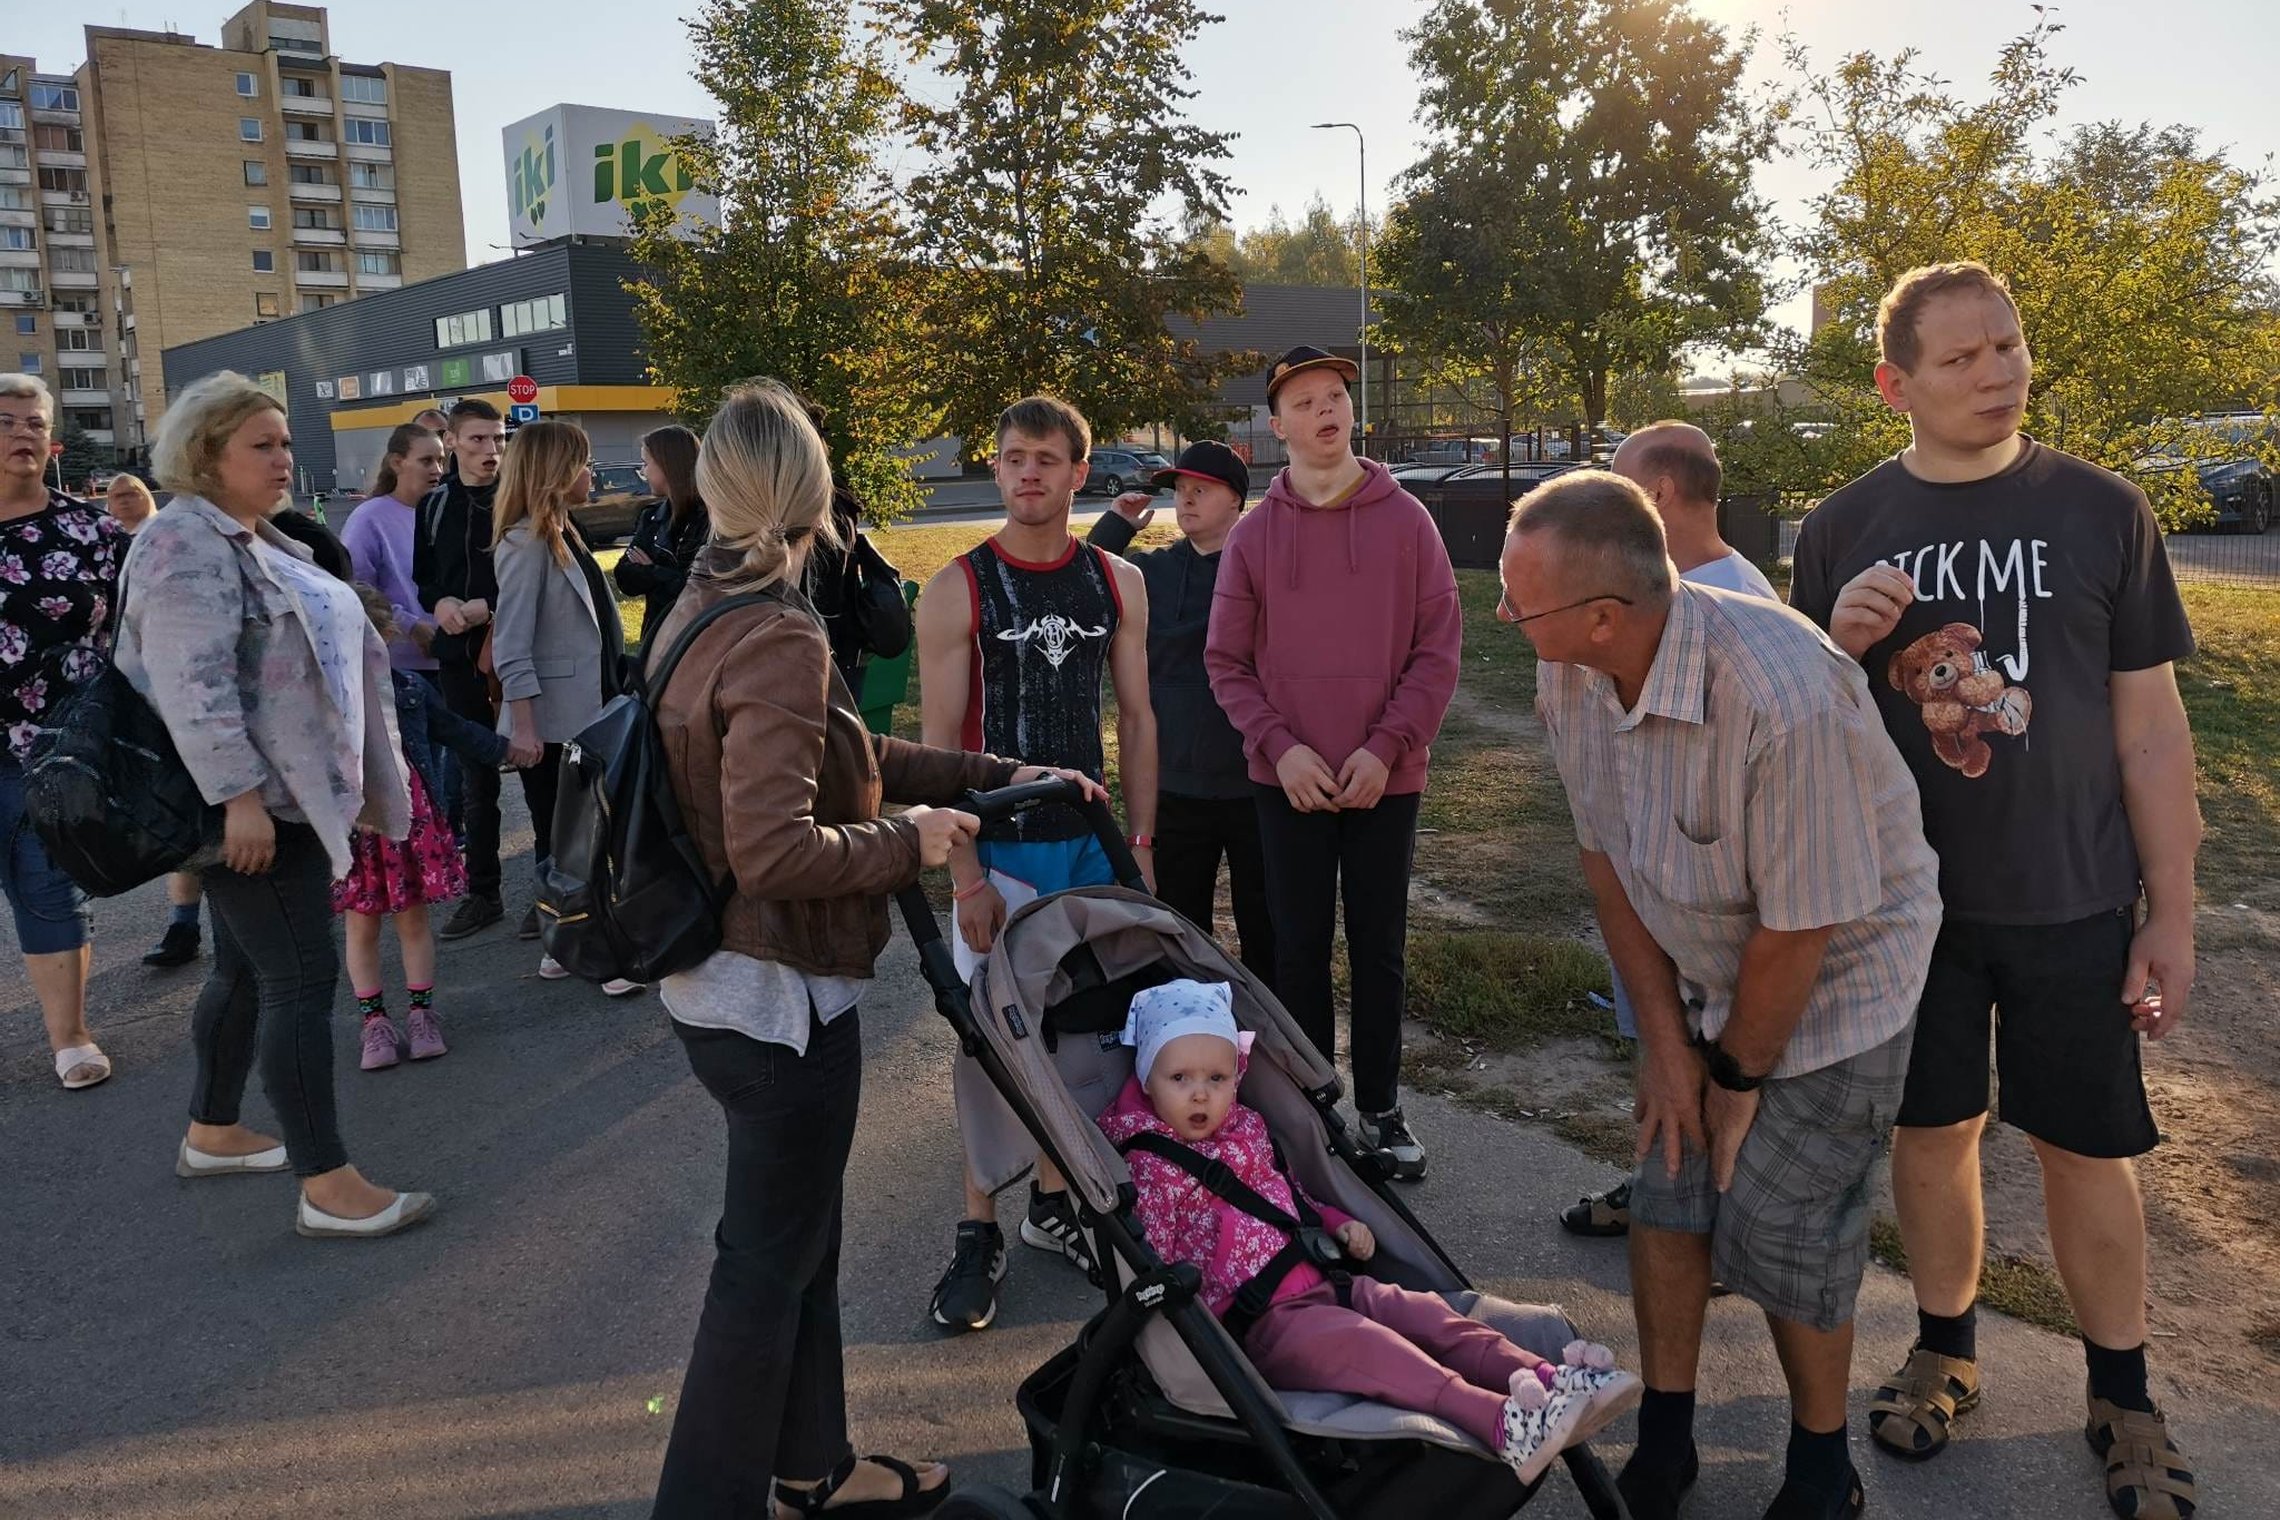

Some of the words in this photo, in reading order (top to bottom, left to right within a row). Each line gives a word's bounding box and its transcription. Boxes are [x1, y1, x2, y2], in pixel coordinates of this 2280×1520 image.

[510, 384, 536, 395] STOP
[518, 406, 534, 422] P
[1977, 538, 2053, 601] ME
